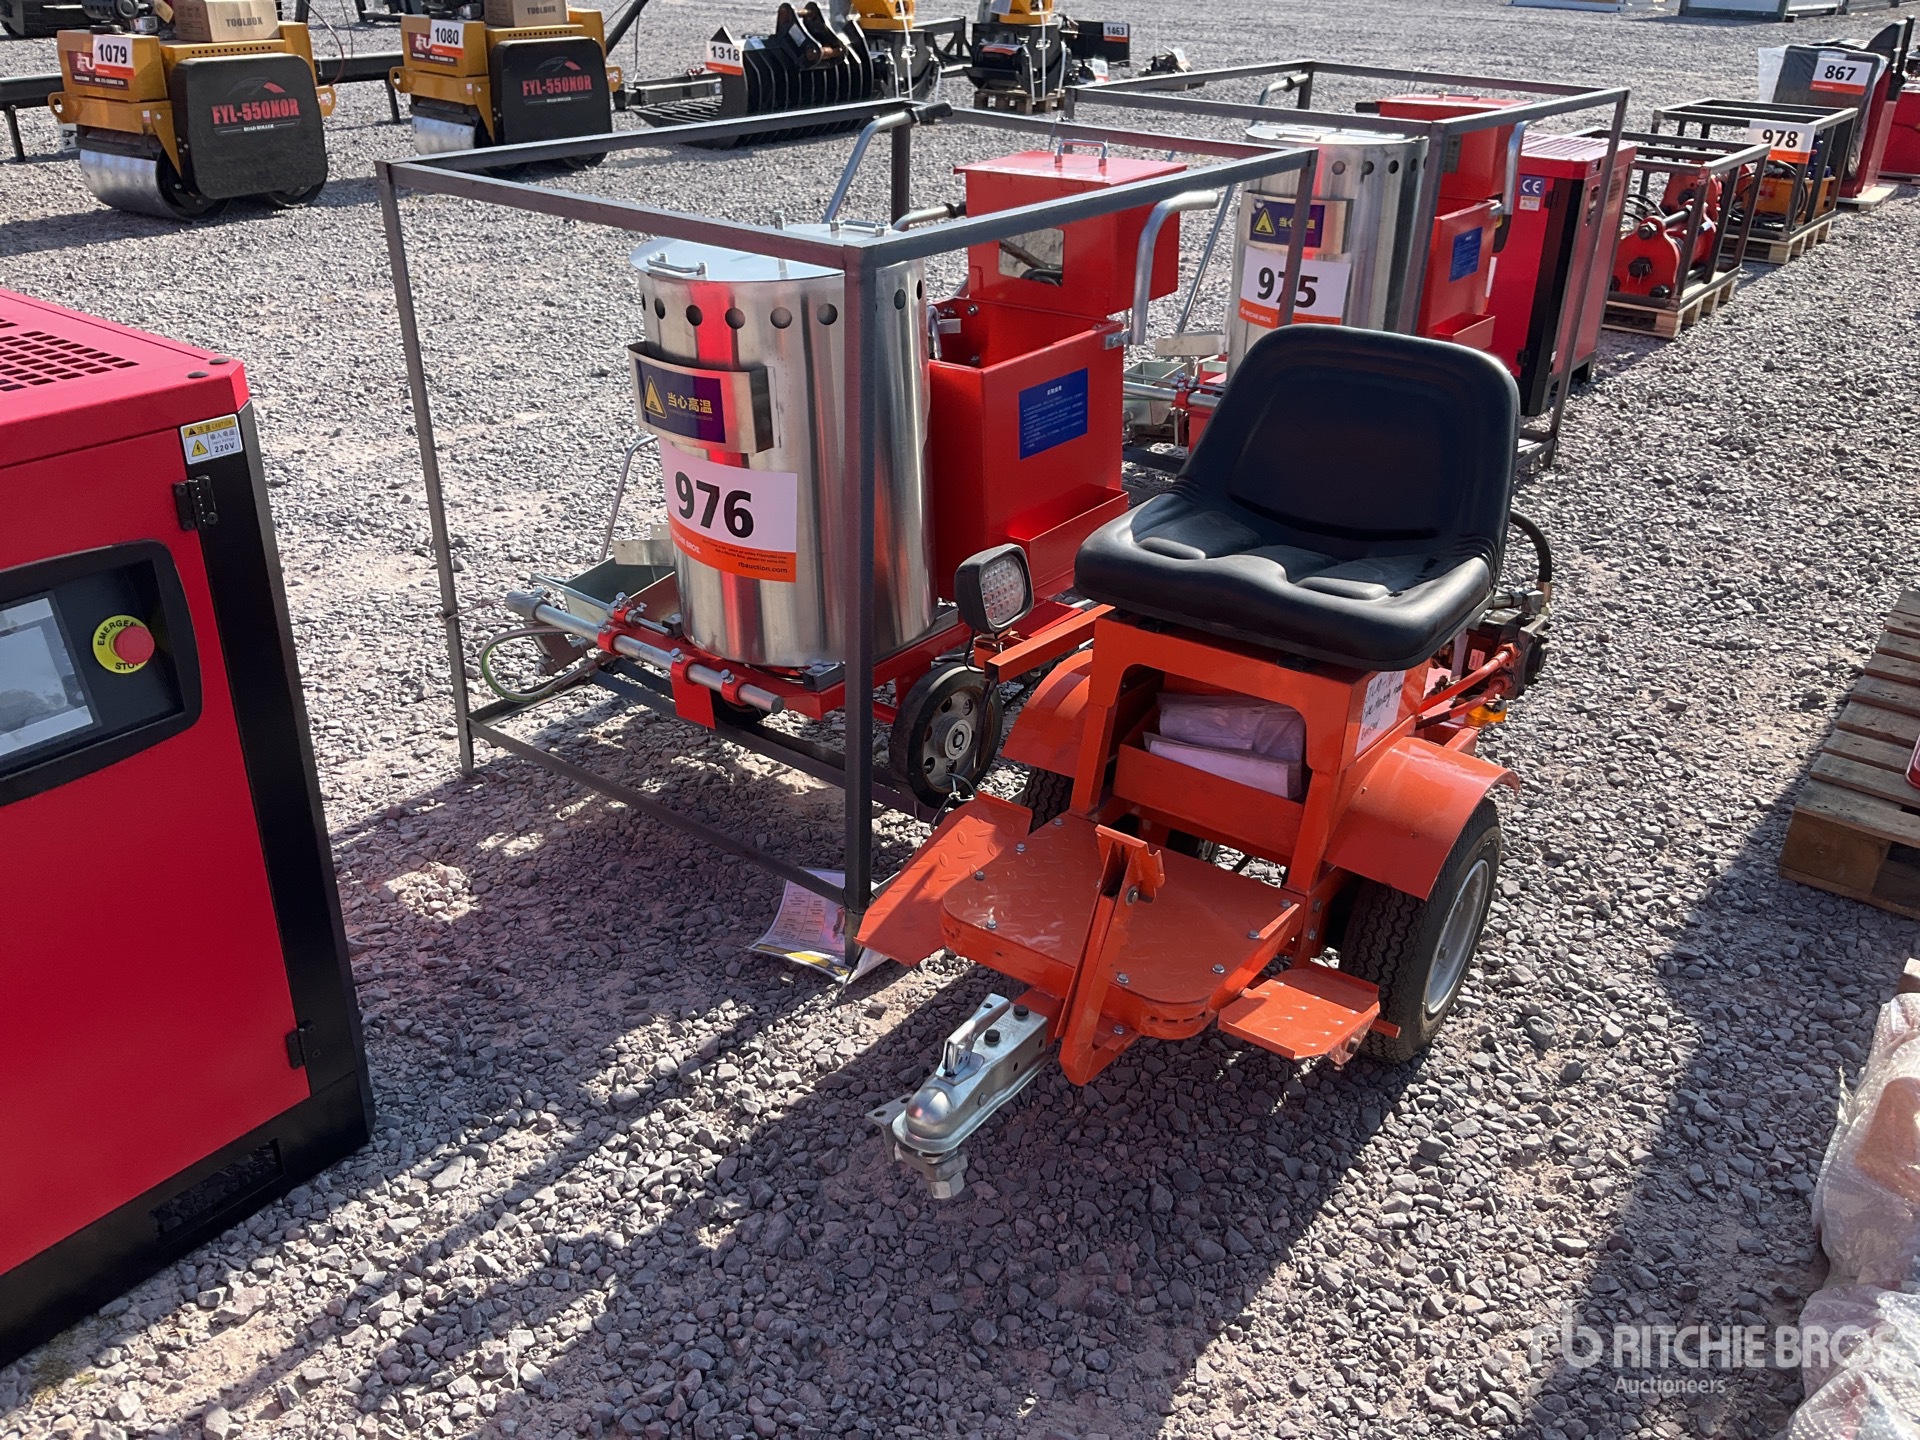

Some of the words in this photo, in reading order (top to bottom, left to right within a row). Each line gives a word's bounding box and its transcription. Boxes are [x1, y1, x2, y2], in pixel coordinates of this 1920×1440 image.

[225, 16, 263, 27] TOOLBOX
[434, 27, 460, 45] 1080
[1106, 26, 1125, 36] 1463
[98, 43, 127, 64] 1079
[711, 45, 740, 61] 1318
[1824, 65, 1857, 81] 867
[1762, 129, 1799, 148] 978
[667, 391, 713, 414] 当心高温
[214, 441, 236, 453] 220V
[675, 471, 755, 538] 976
[737, 560, 788, 574] rbauction.com
[97, 619, 138, 646] EMERGEN
[115, 661, 140, 671] STO
